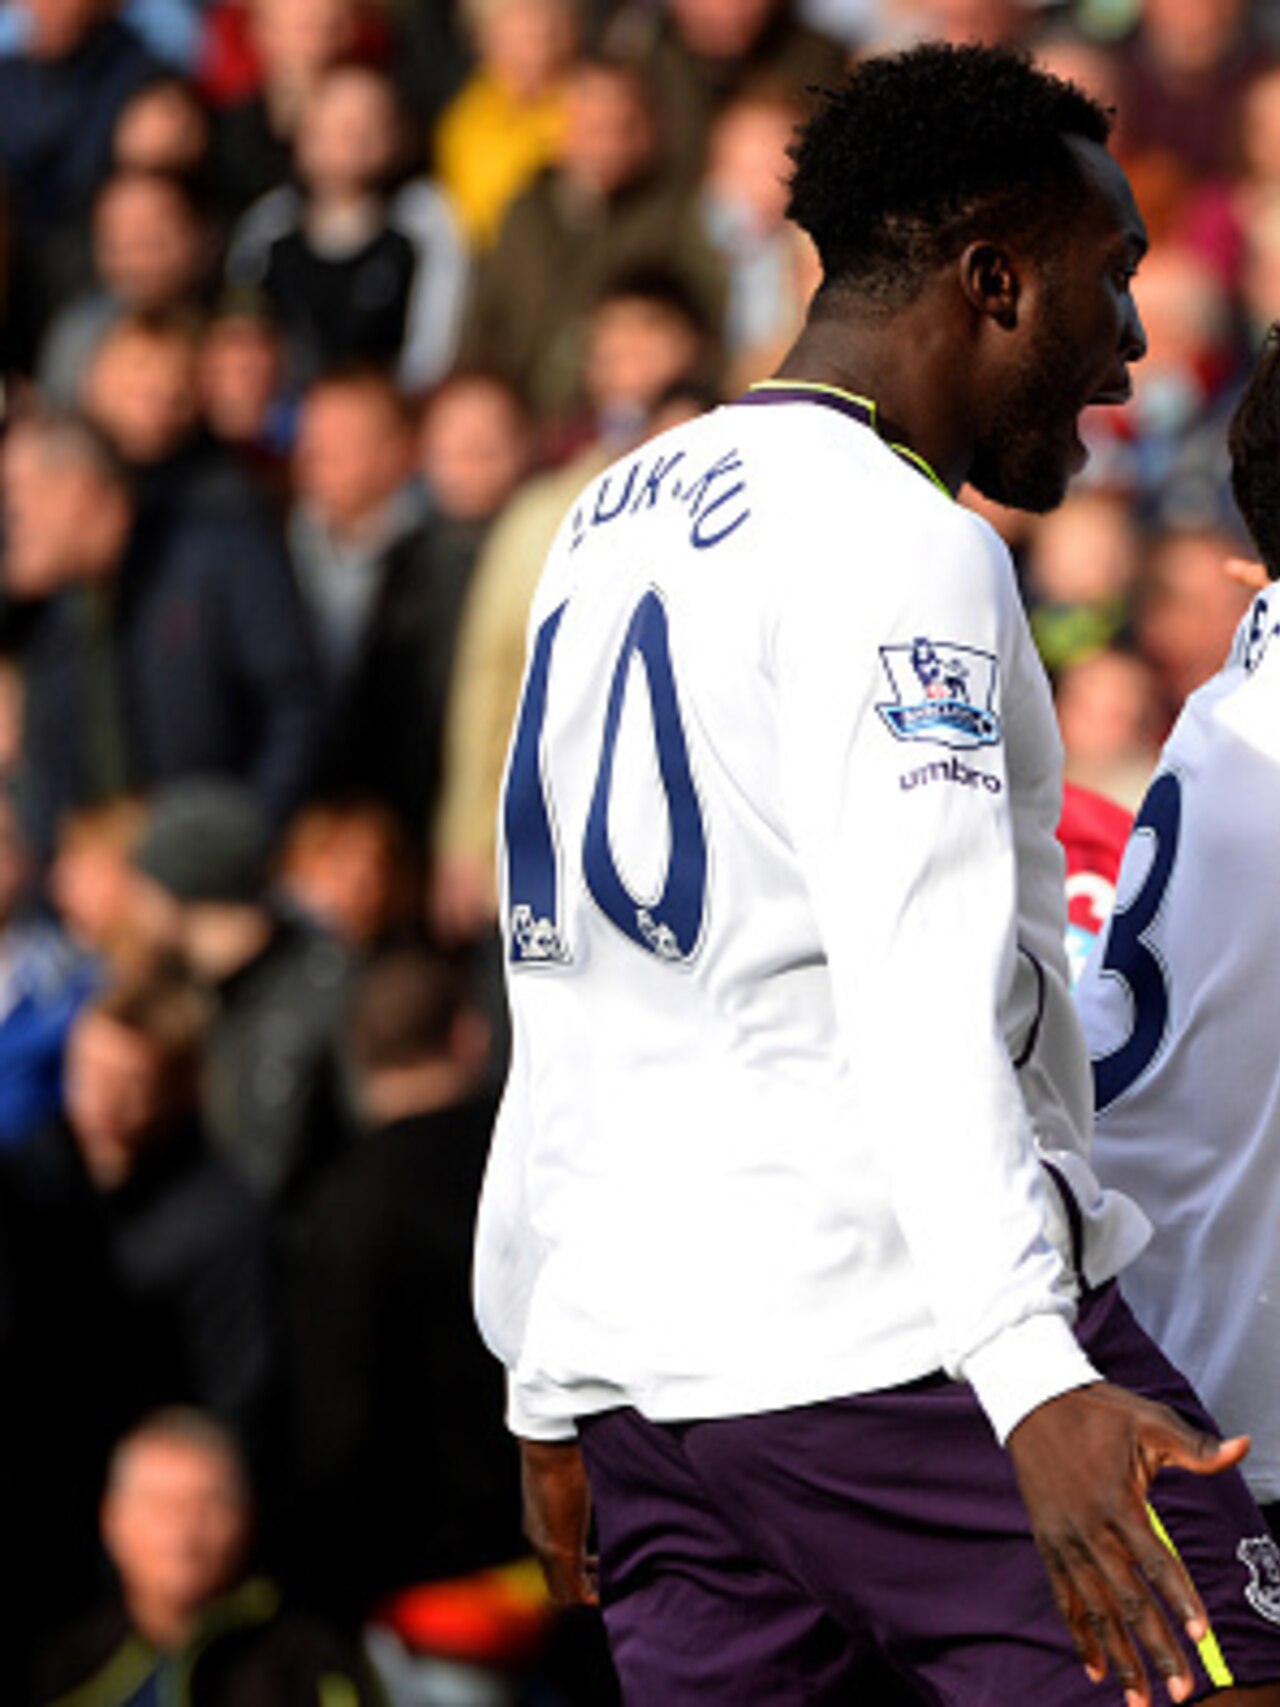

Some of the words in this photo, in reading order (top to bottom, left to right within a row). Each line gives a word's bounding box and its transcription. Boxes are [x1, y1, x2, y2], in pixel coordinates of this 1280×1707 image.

[503, 586, 709, 968] 10
[899, 757, 1002, 794] umbro
[1092, 768, 1184, 1116] 3
